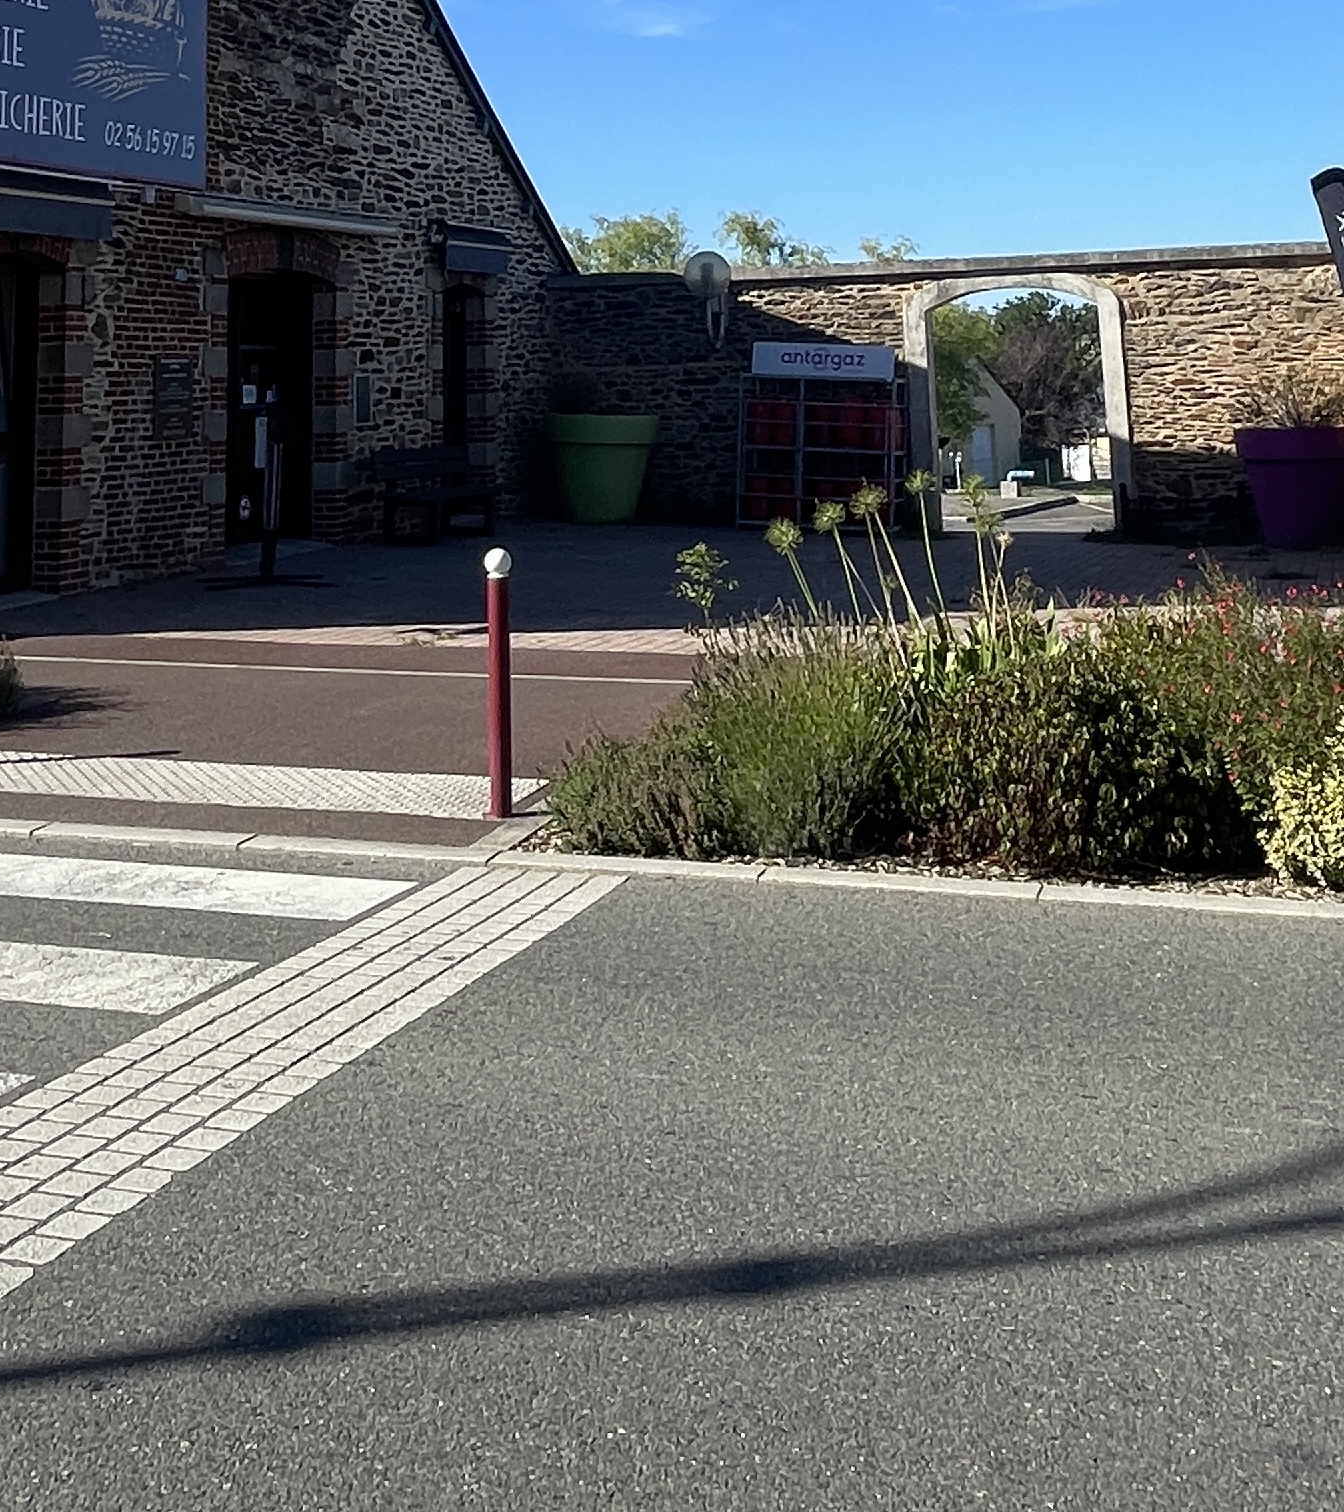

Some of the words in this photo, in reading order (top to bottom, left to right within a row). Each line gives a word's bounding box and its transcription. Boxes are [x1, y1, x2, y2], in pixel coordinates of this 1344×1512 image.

[104, 120, 123, 148] 02
[125, 124, 142, 152] 56
[146, 128, 161, 155] 15
[162, 131, 180, 157] 97
[181, 134, 197, 161] 15
[780, 350, 866, 371] antargaz
